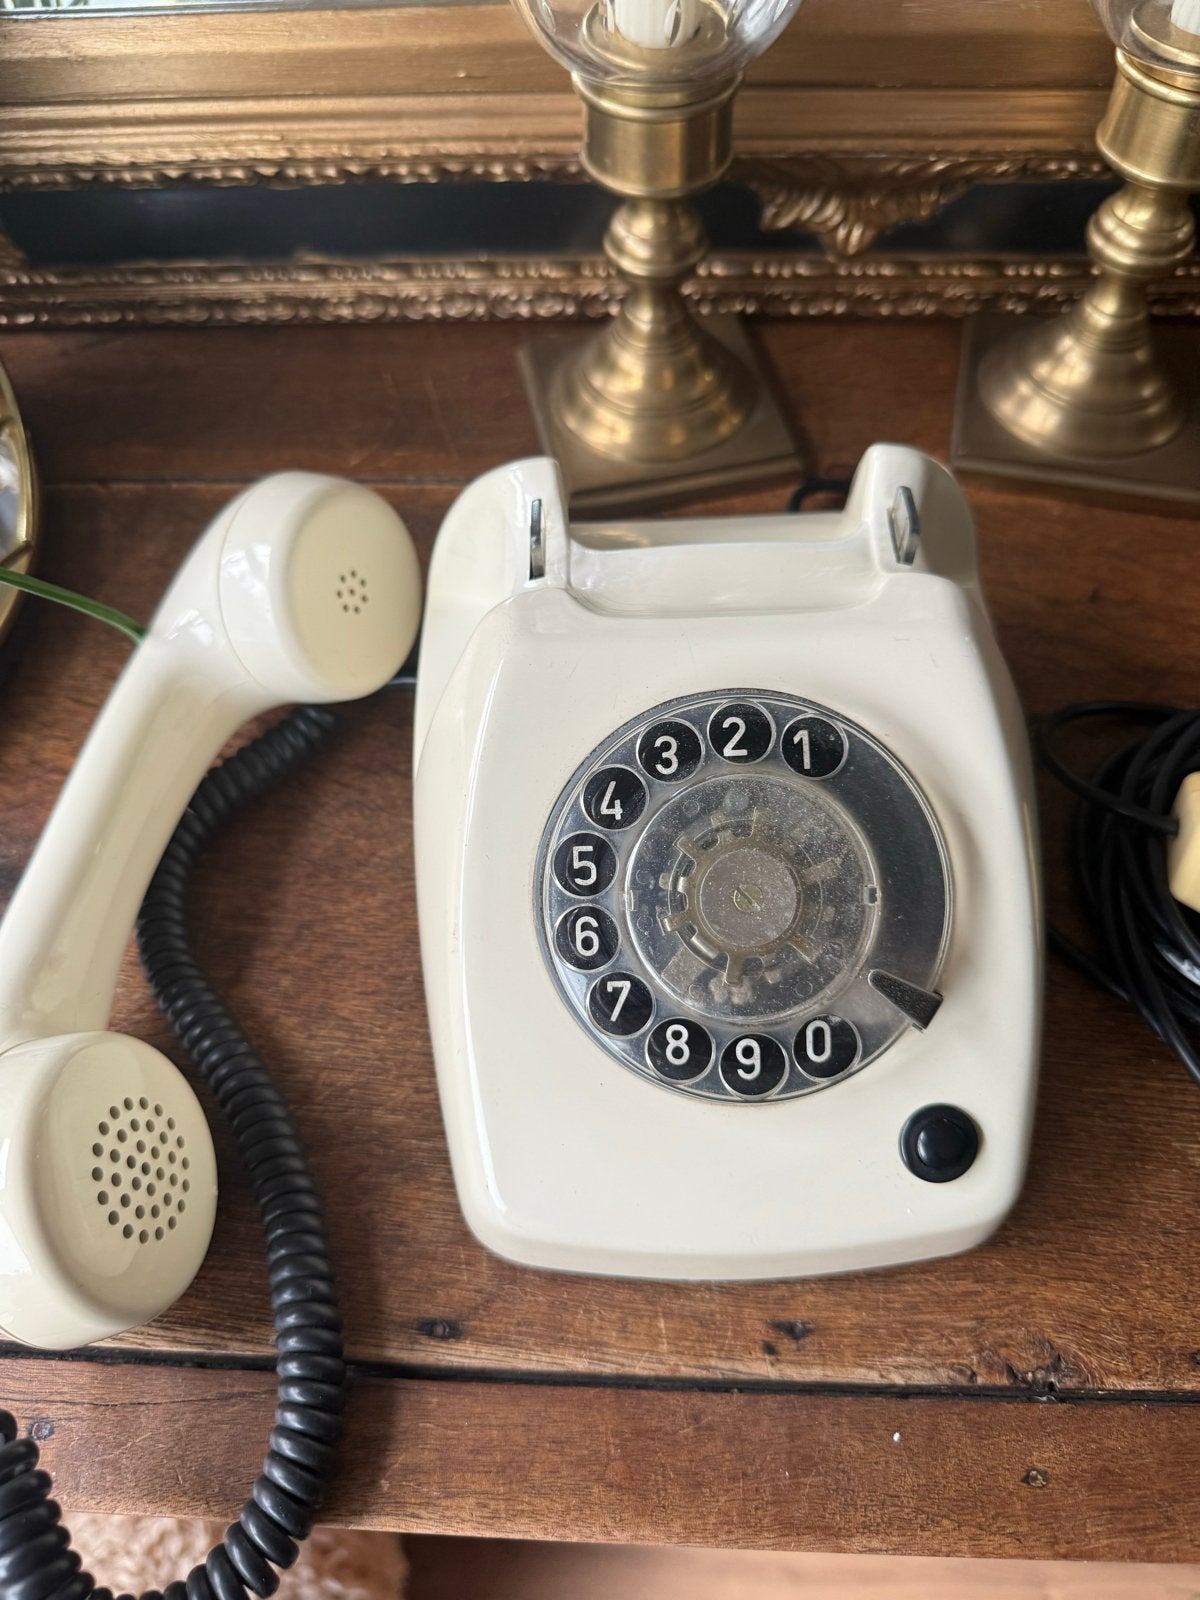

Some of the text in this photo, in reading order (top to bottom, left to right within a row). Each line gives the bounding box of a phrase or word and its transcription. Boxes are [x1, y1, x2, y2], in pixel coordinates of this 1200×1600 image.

[654, 735, 679, 775] 3
[722, 716, 748, 757] 2
[792, 728, 812, 770] 1
[600, 780, 623, 821] 4
[572, 845, 597, 886] 5
[575, 915, 600, 957] 6
[606, 980, 632, 1022] 7
[665, 1024, 690, 1066] 8
[735, 1038, 761, 1080] 9
[805, 1020, 831, 1063] 0
